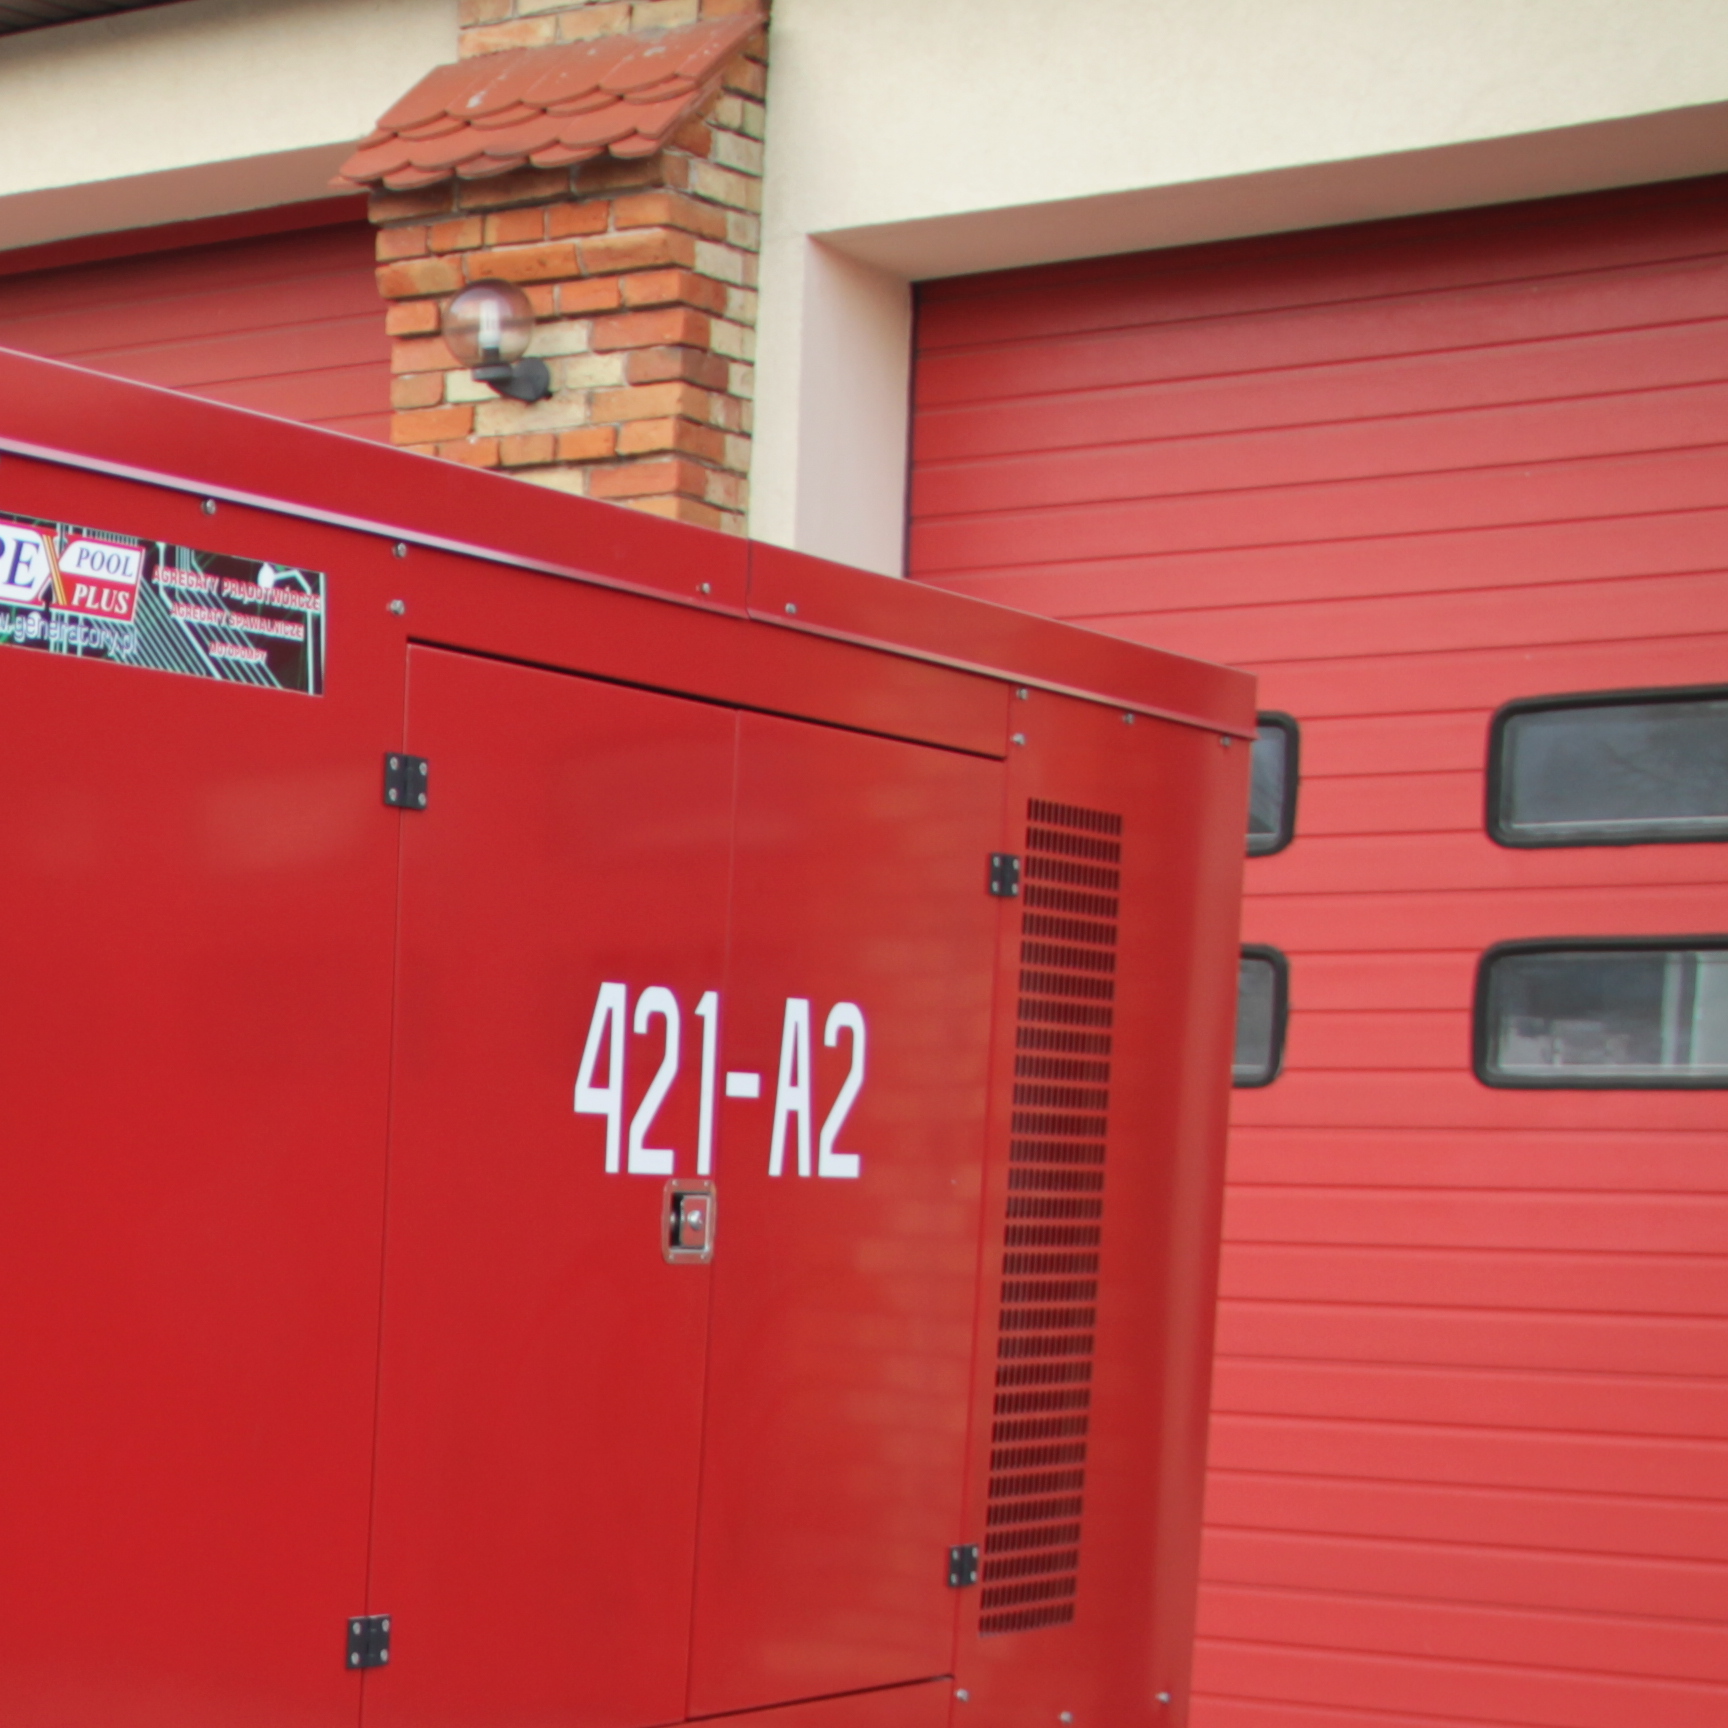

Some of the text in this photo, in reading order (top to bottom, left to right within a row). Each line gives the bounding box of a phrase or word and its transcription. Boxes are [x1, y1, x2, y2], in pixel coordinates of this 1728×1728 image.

[75, 546, 134, 578] POOL
[71, 583, 130, 615] PLUS
[152, 565, 322, 613] AGREGATY PRĄDOTWÓRCZE
[170, 601, 305, 641] AGREGATY SPAWALNICZE
[573, 981, 867, 1179] 421-A2
